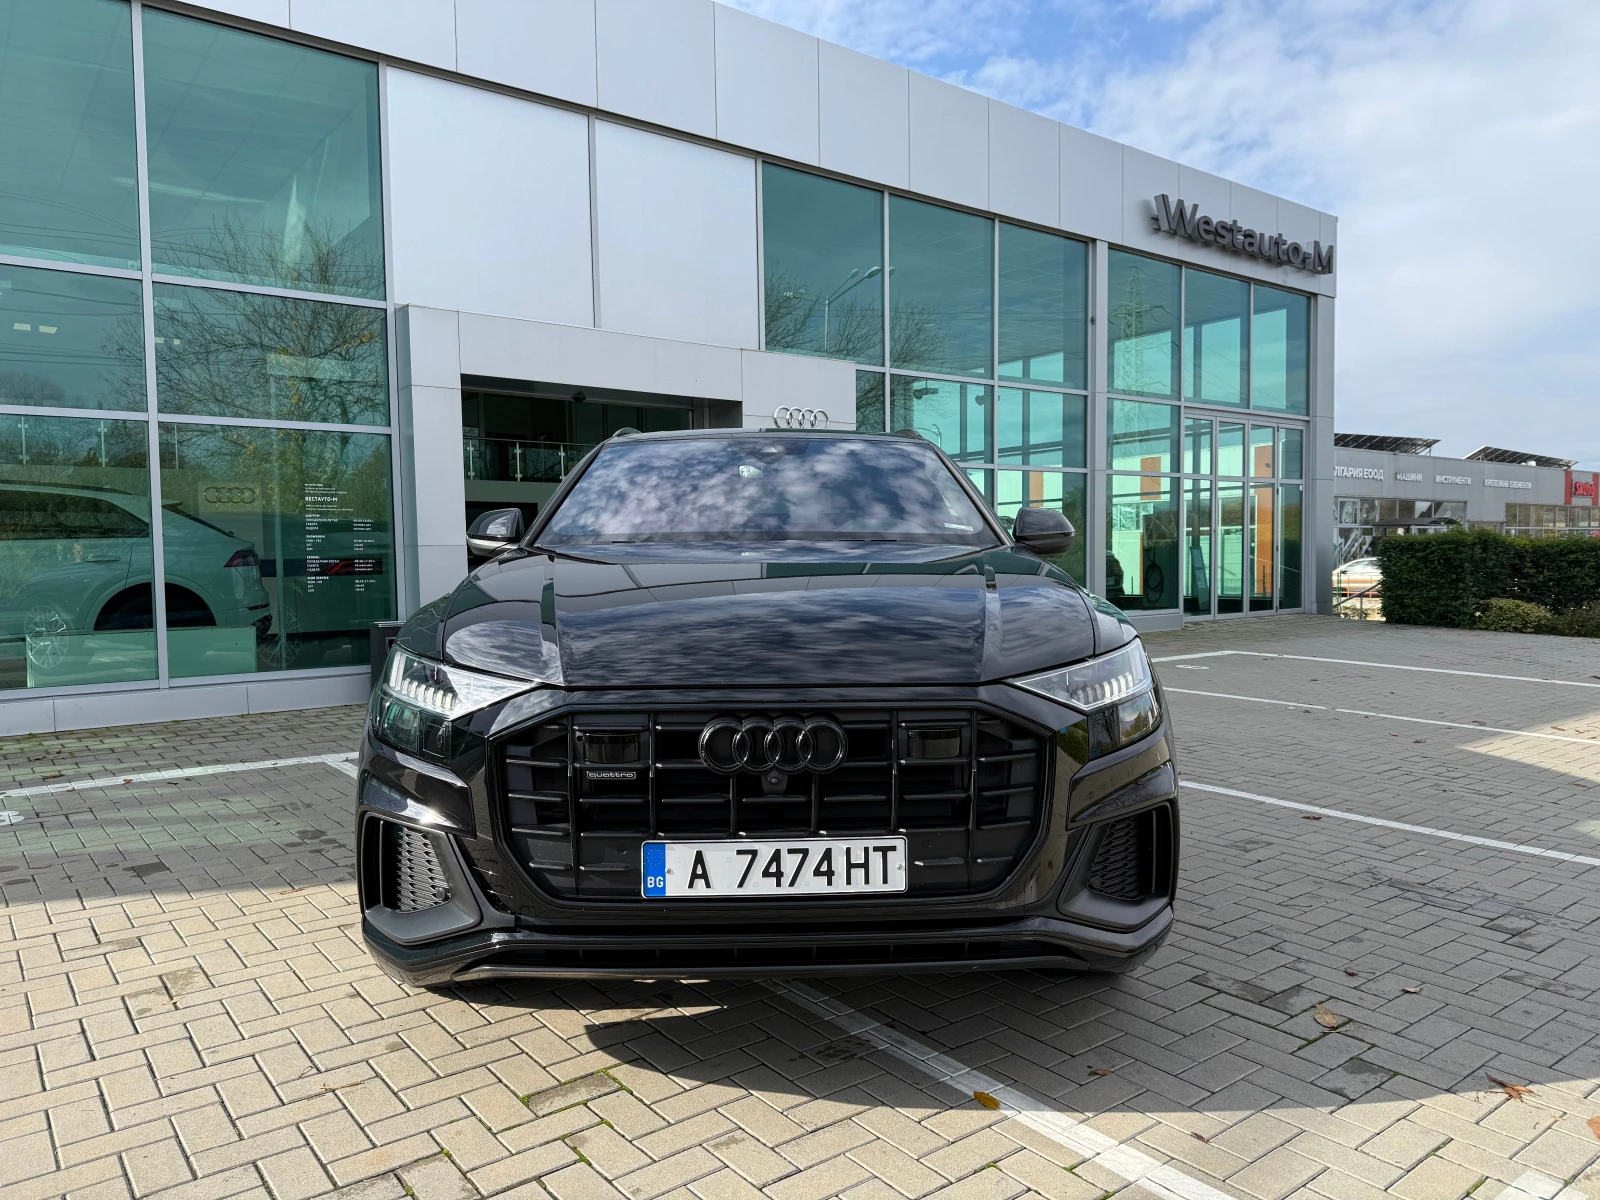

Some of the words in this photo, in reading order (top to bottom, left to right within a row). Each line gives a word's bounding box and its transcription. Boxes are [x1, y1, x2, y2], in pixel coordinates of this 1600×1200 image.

[1152, 193, 1334, 275] Westauto-M
[1363, 468, 1384, 481] ЕООД
[1396, 472, 1423, 482] МАШИНИ
[1435, 475, 1472, 486] ИНСТРУМЕНТИ
[588, 771, 634, 779] quattro
[647, 876, 664, 889] BG
[686, 849, 712, 890] A
